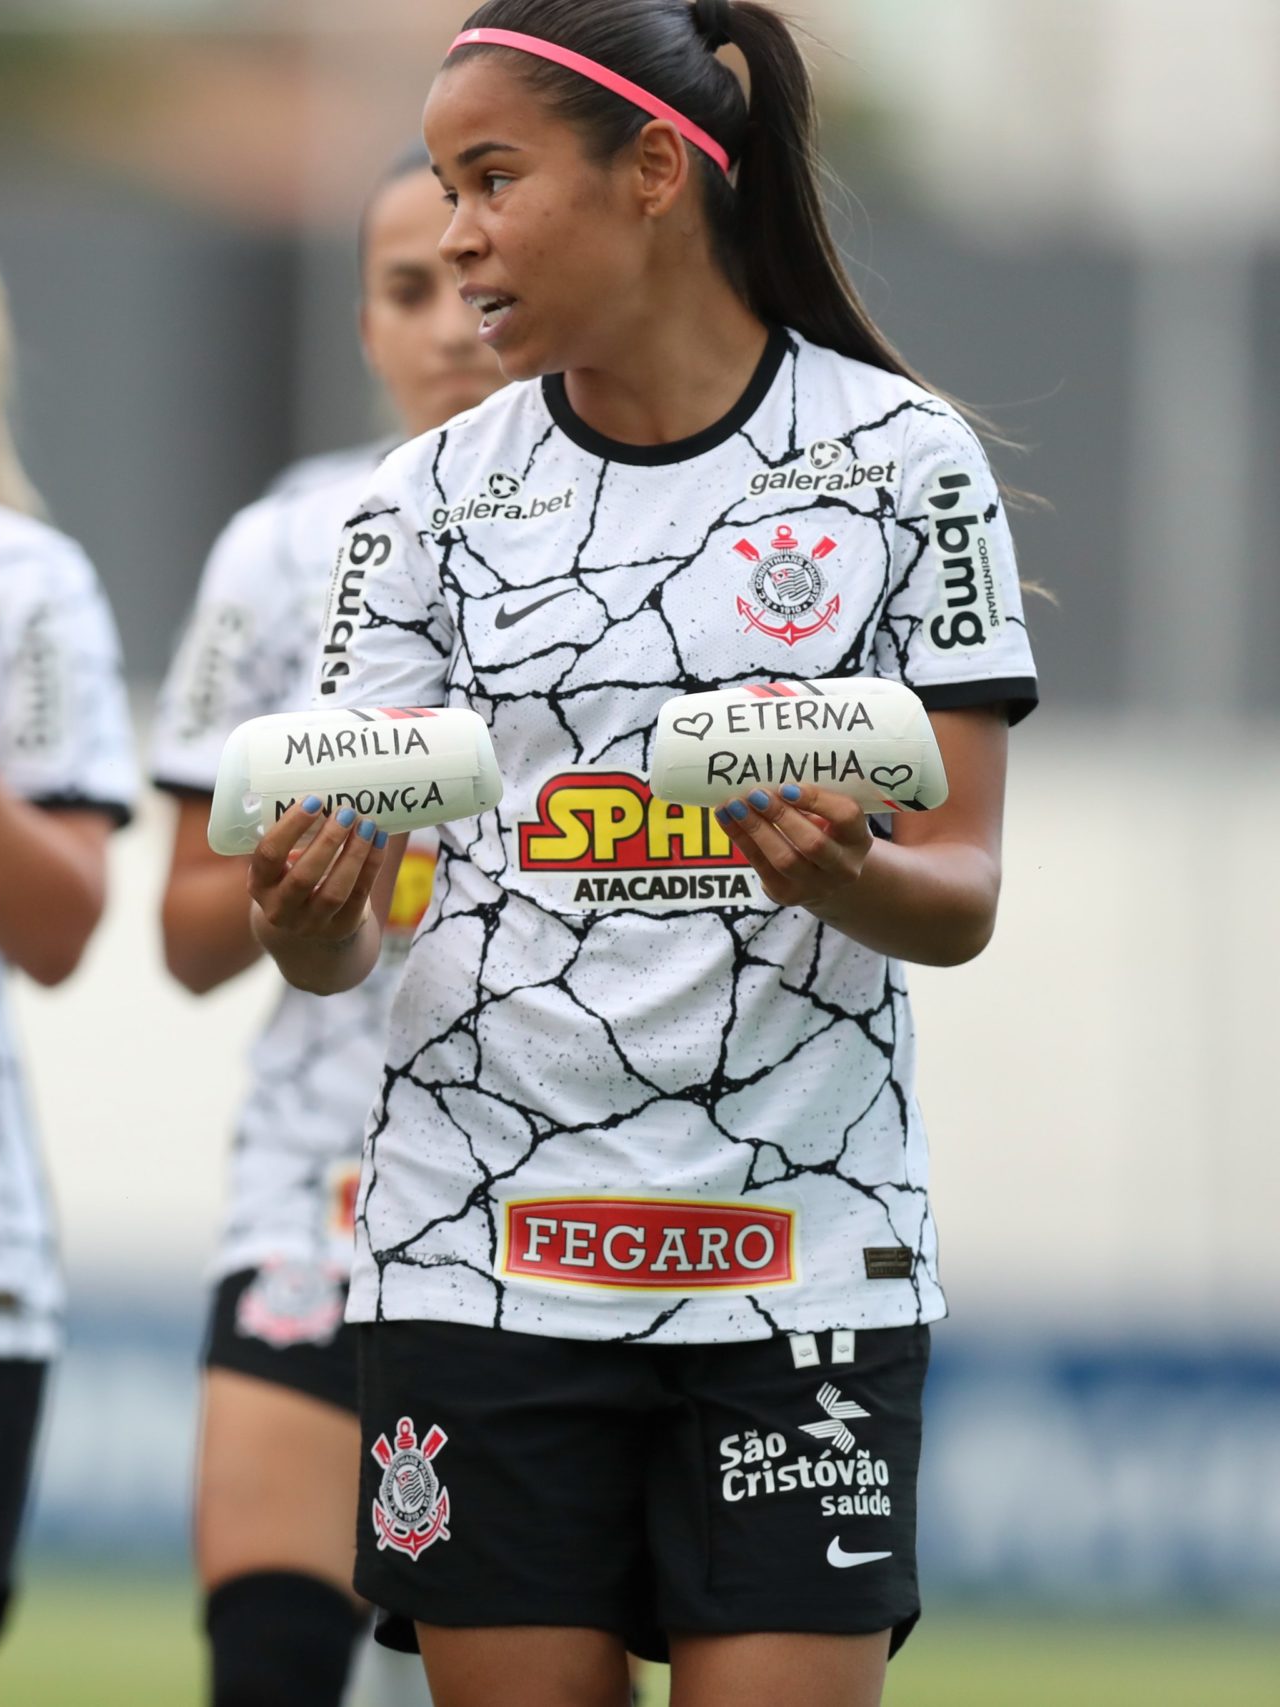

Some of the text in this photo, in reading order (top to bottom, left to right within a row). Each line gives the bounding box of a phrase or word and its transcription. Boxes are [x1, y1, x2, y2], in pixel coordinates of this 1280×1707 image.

[750, 461, 896, 494] galera.bet
[430, 488, 574, 530] galera.bet
[324, 532, 391, 654] bmg
[755, 555, 804, 589] CORINTHIANS
[805, 563, 820, 603] PAULISTA
[930, 514, 986, 650] bmg
[977, 537, 1000, 627] CORINTHIANS
[781, 605, 802, 614] 1910
[727, 700, 874, 734] ETERNA
[285, 727, 429, 766] MARÍLIA
[707, 750, 865, 786] RAINHA
[275, 781, 444, 822] MNDONÇA
[529, 787, 730, 861] SPA
[574, 874, 751, 902] ATACADISTA
[522, 1216, 775, 1272] FEGARO
[720, 1430, 786, 1471] São
[722, 1449, 889, 1502] Cristóvão
[820, 1489, 891, 1517] saúde
